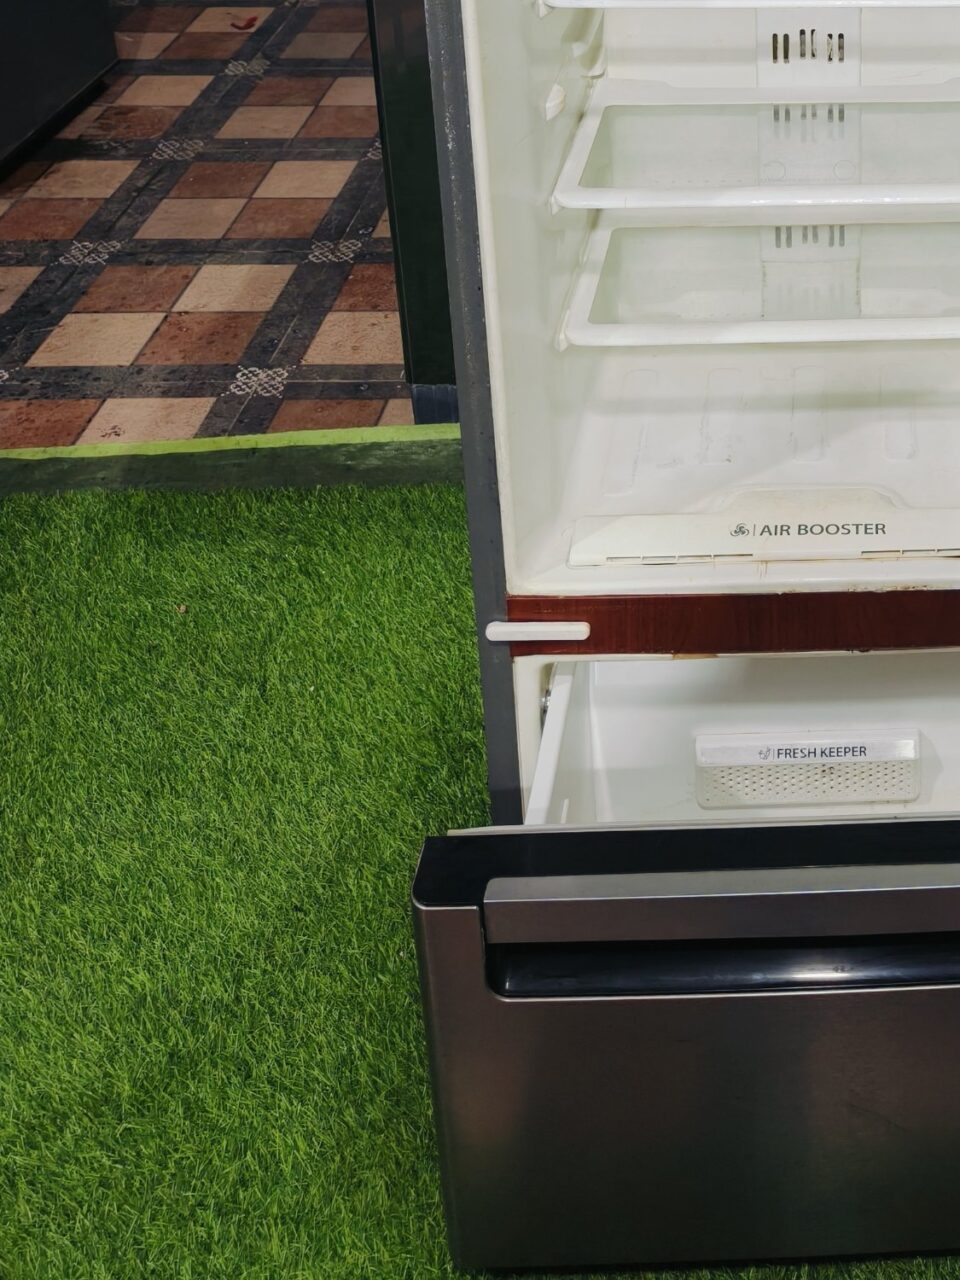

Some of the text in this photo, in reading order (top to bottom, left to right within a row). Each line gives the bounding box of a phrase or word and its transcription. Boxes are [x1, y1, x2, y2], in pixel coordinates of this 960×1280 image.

[759, 523, 887, 536] AIR BOOSTER
[777, 746, 867, 759] FRESH KEEPER
